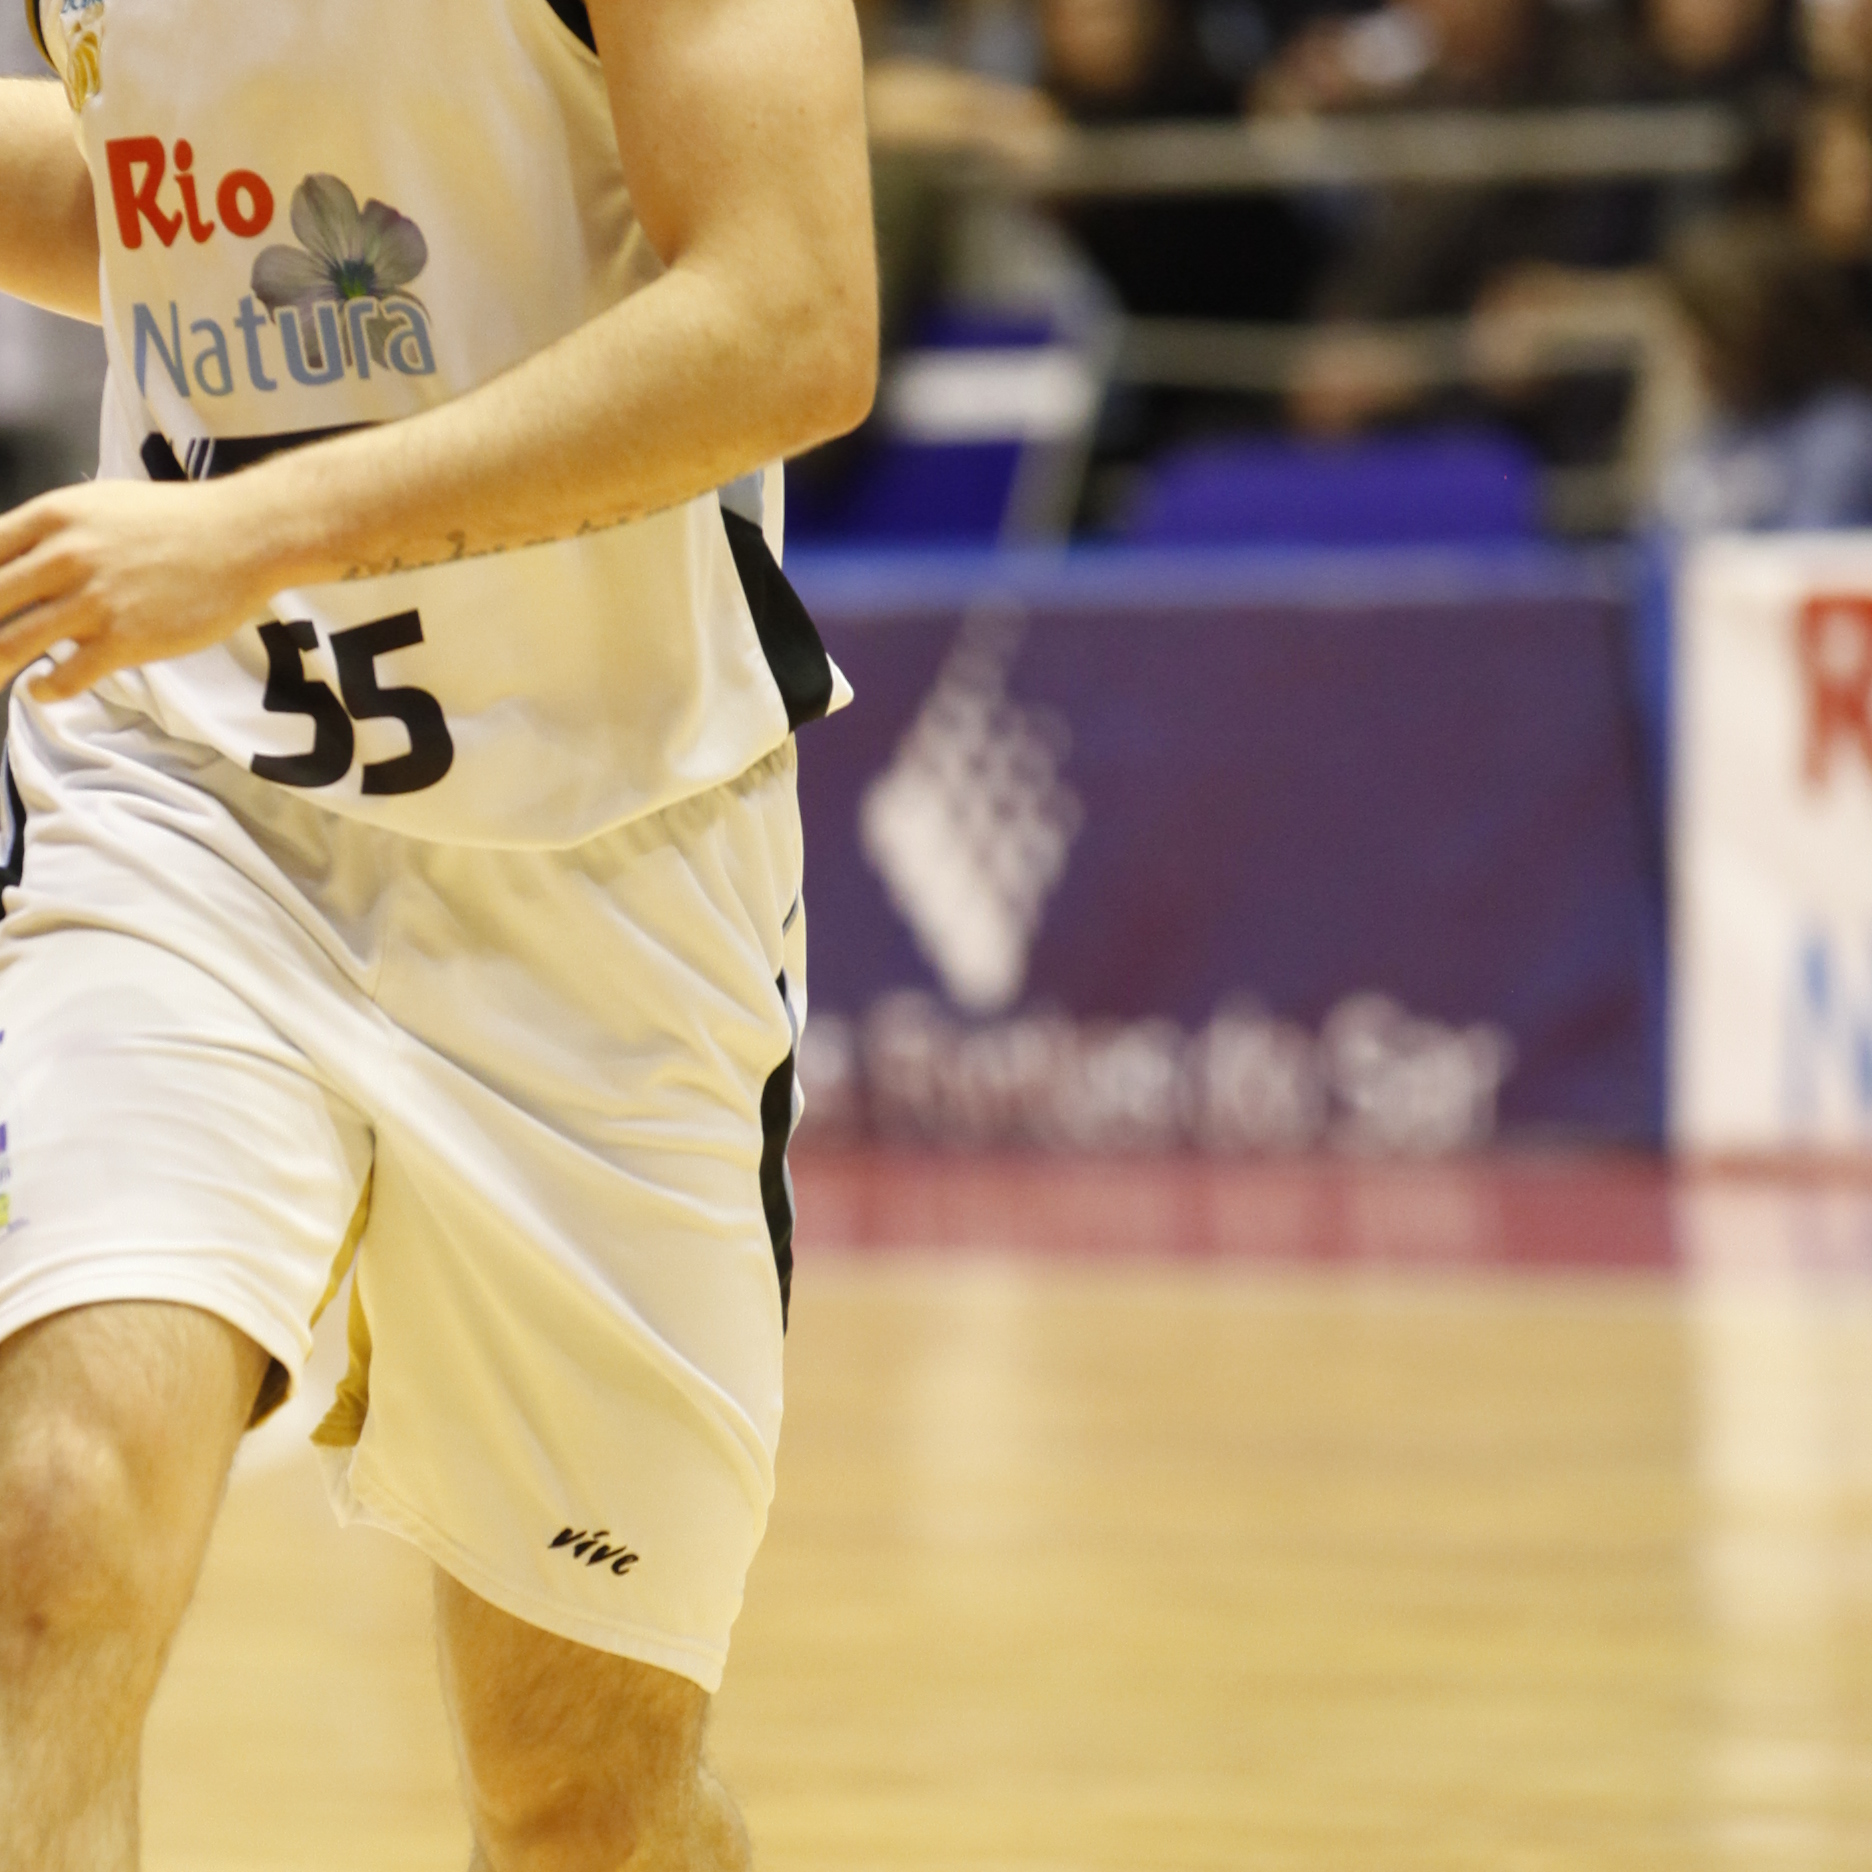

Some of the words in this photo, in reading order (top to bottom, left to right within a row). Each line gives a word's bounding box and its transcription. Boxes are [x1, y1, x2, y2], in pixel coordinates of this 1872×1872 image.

[104, 134, 275, 250] Rio
[132, 294, 437, 399] Natura
[250, 608, 454, 796] 55
